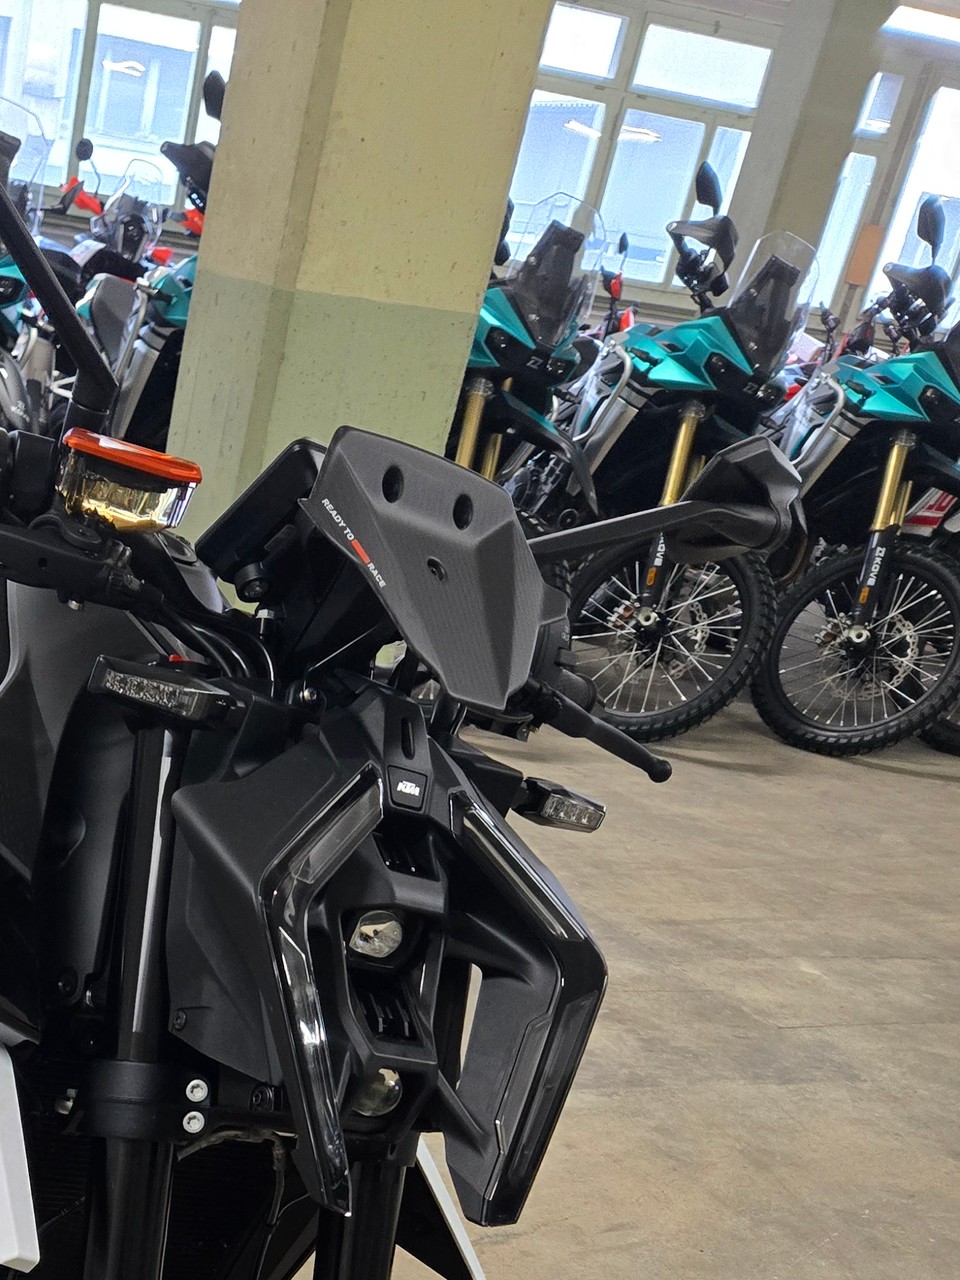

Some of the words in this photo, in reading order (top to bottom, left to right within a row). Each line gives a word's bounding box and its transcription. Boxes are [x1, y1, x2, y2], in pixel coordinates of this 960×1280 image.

[321, 498, 345, 528] READY
[343, 526, 354, 540] TO
[366, 562, 387, 589] RACE
[396, 780, 421, 797] KTM
